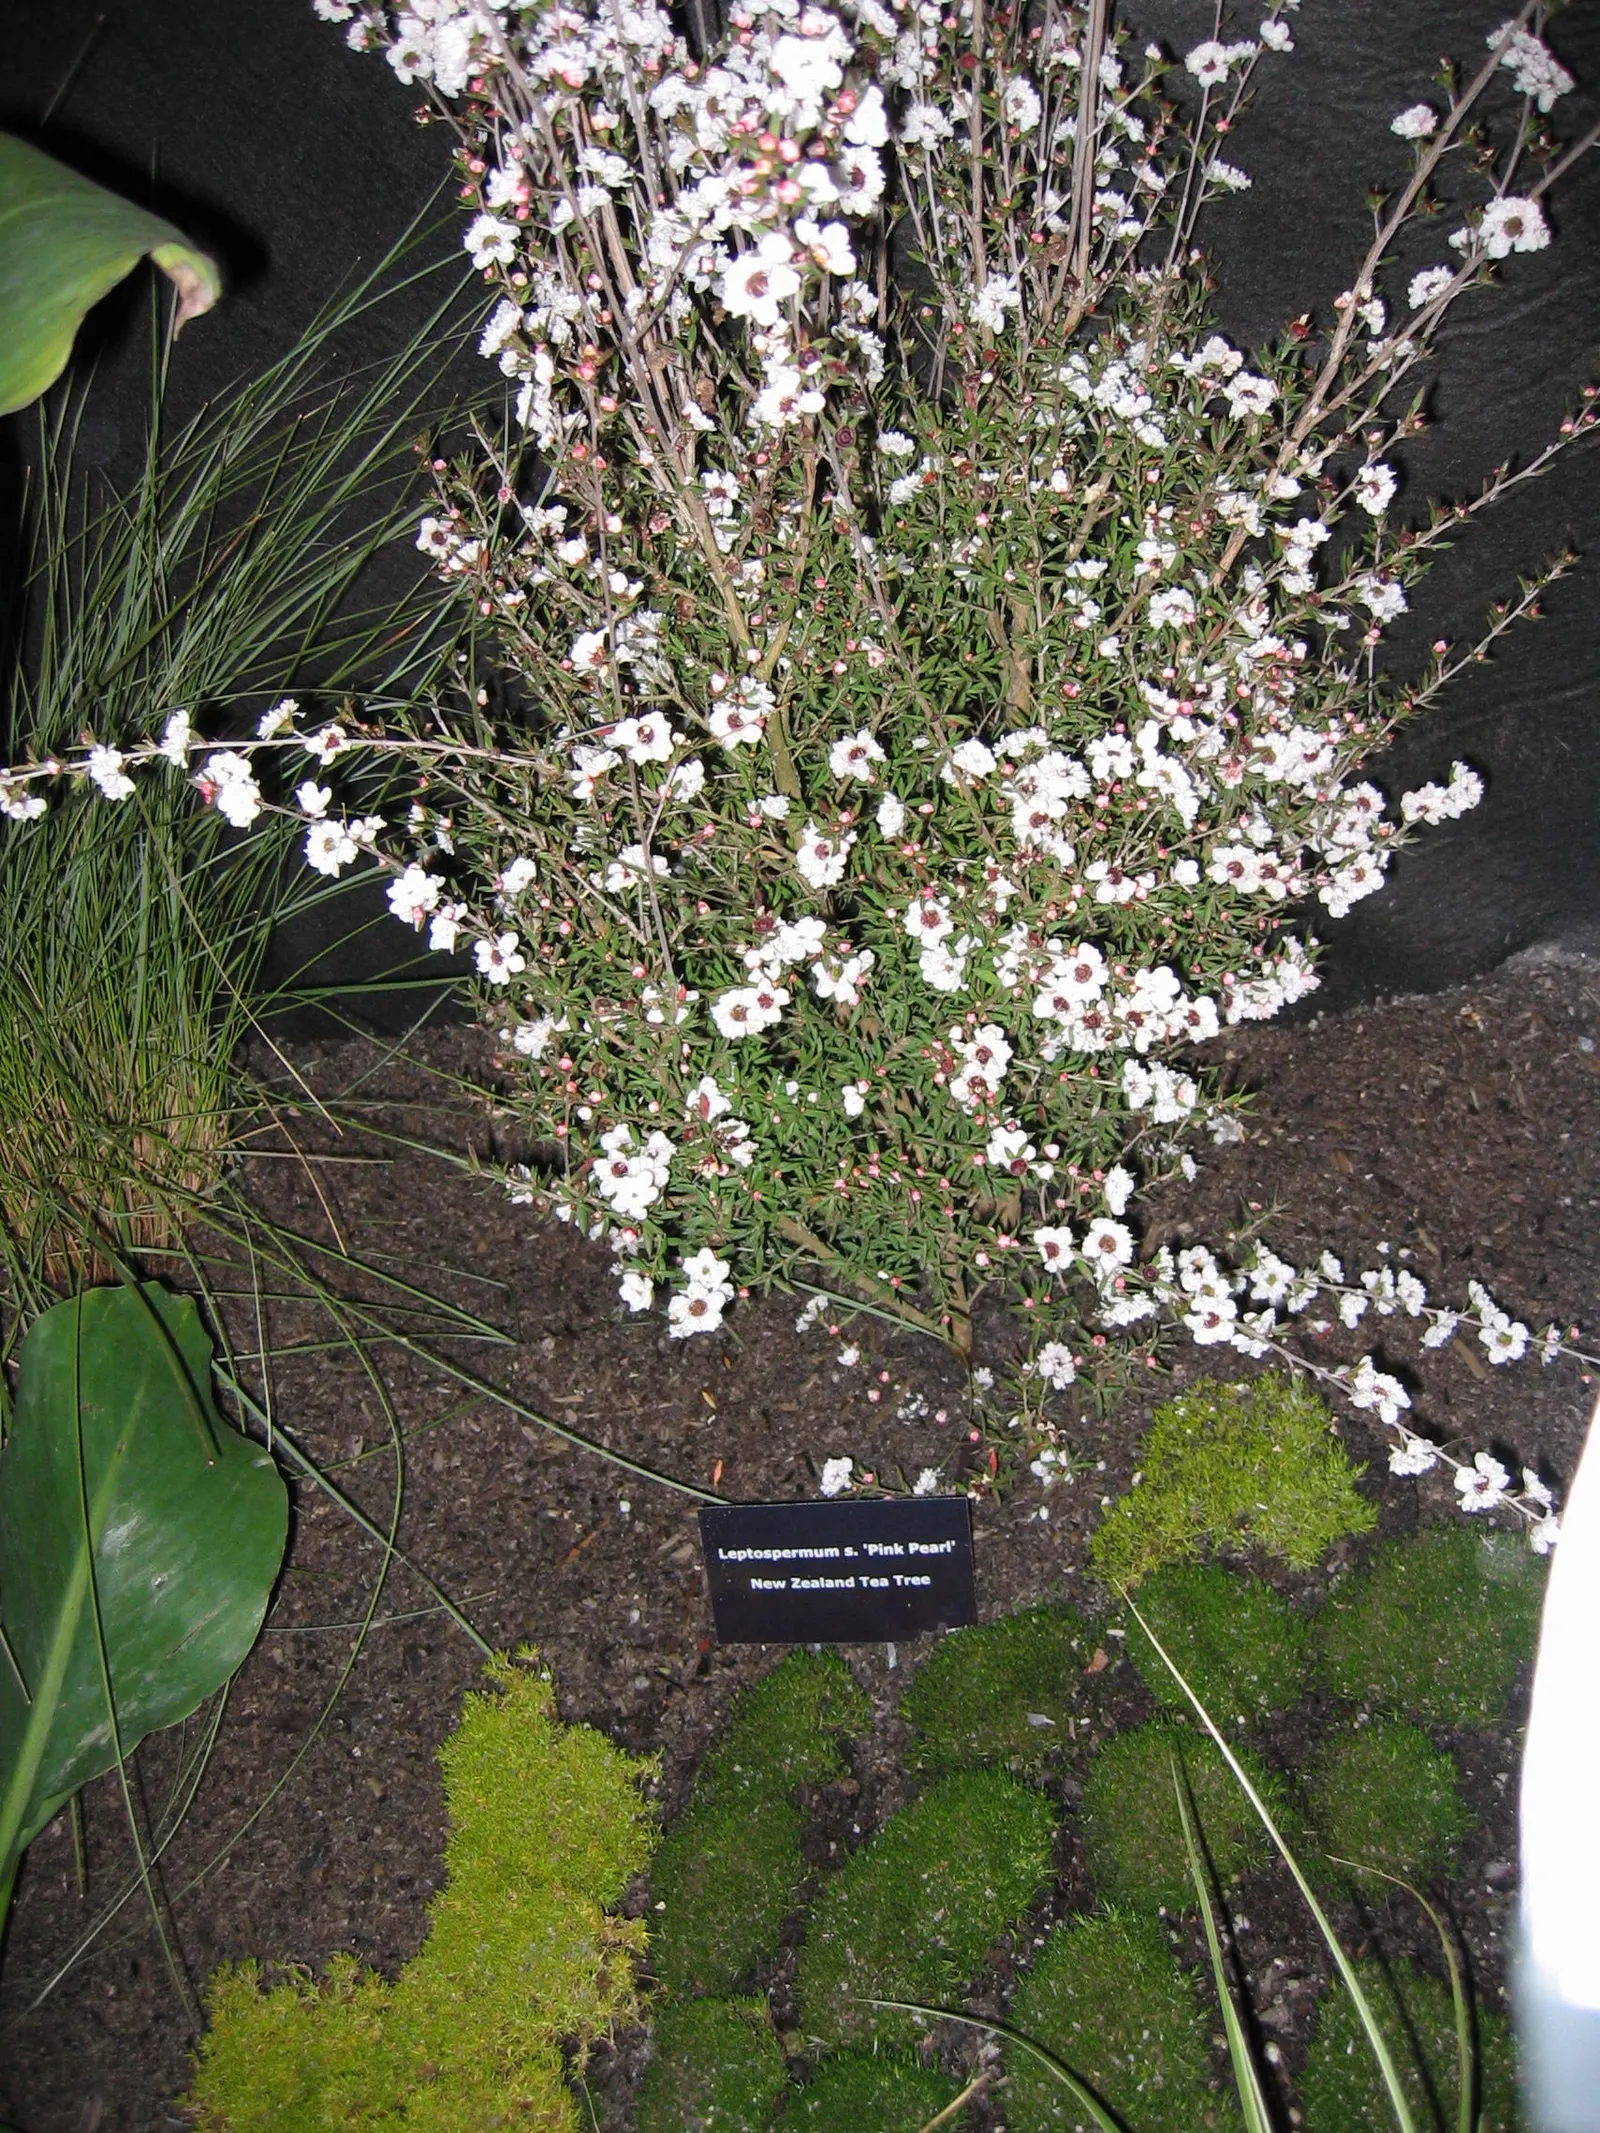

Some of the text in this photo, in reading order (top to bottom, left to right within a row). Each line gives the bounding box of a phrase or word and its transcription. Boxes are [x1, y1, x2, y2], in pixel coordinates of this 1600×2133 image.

[718, 1539, 956, 1562] Leptospermum s. 'Pink Pearl'
[750, 1574, 931, 1590] New Zealand Tea Tree
